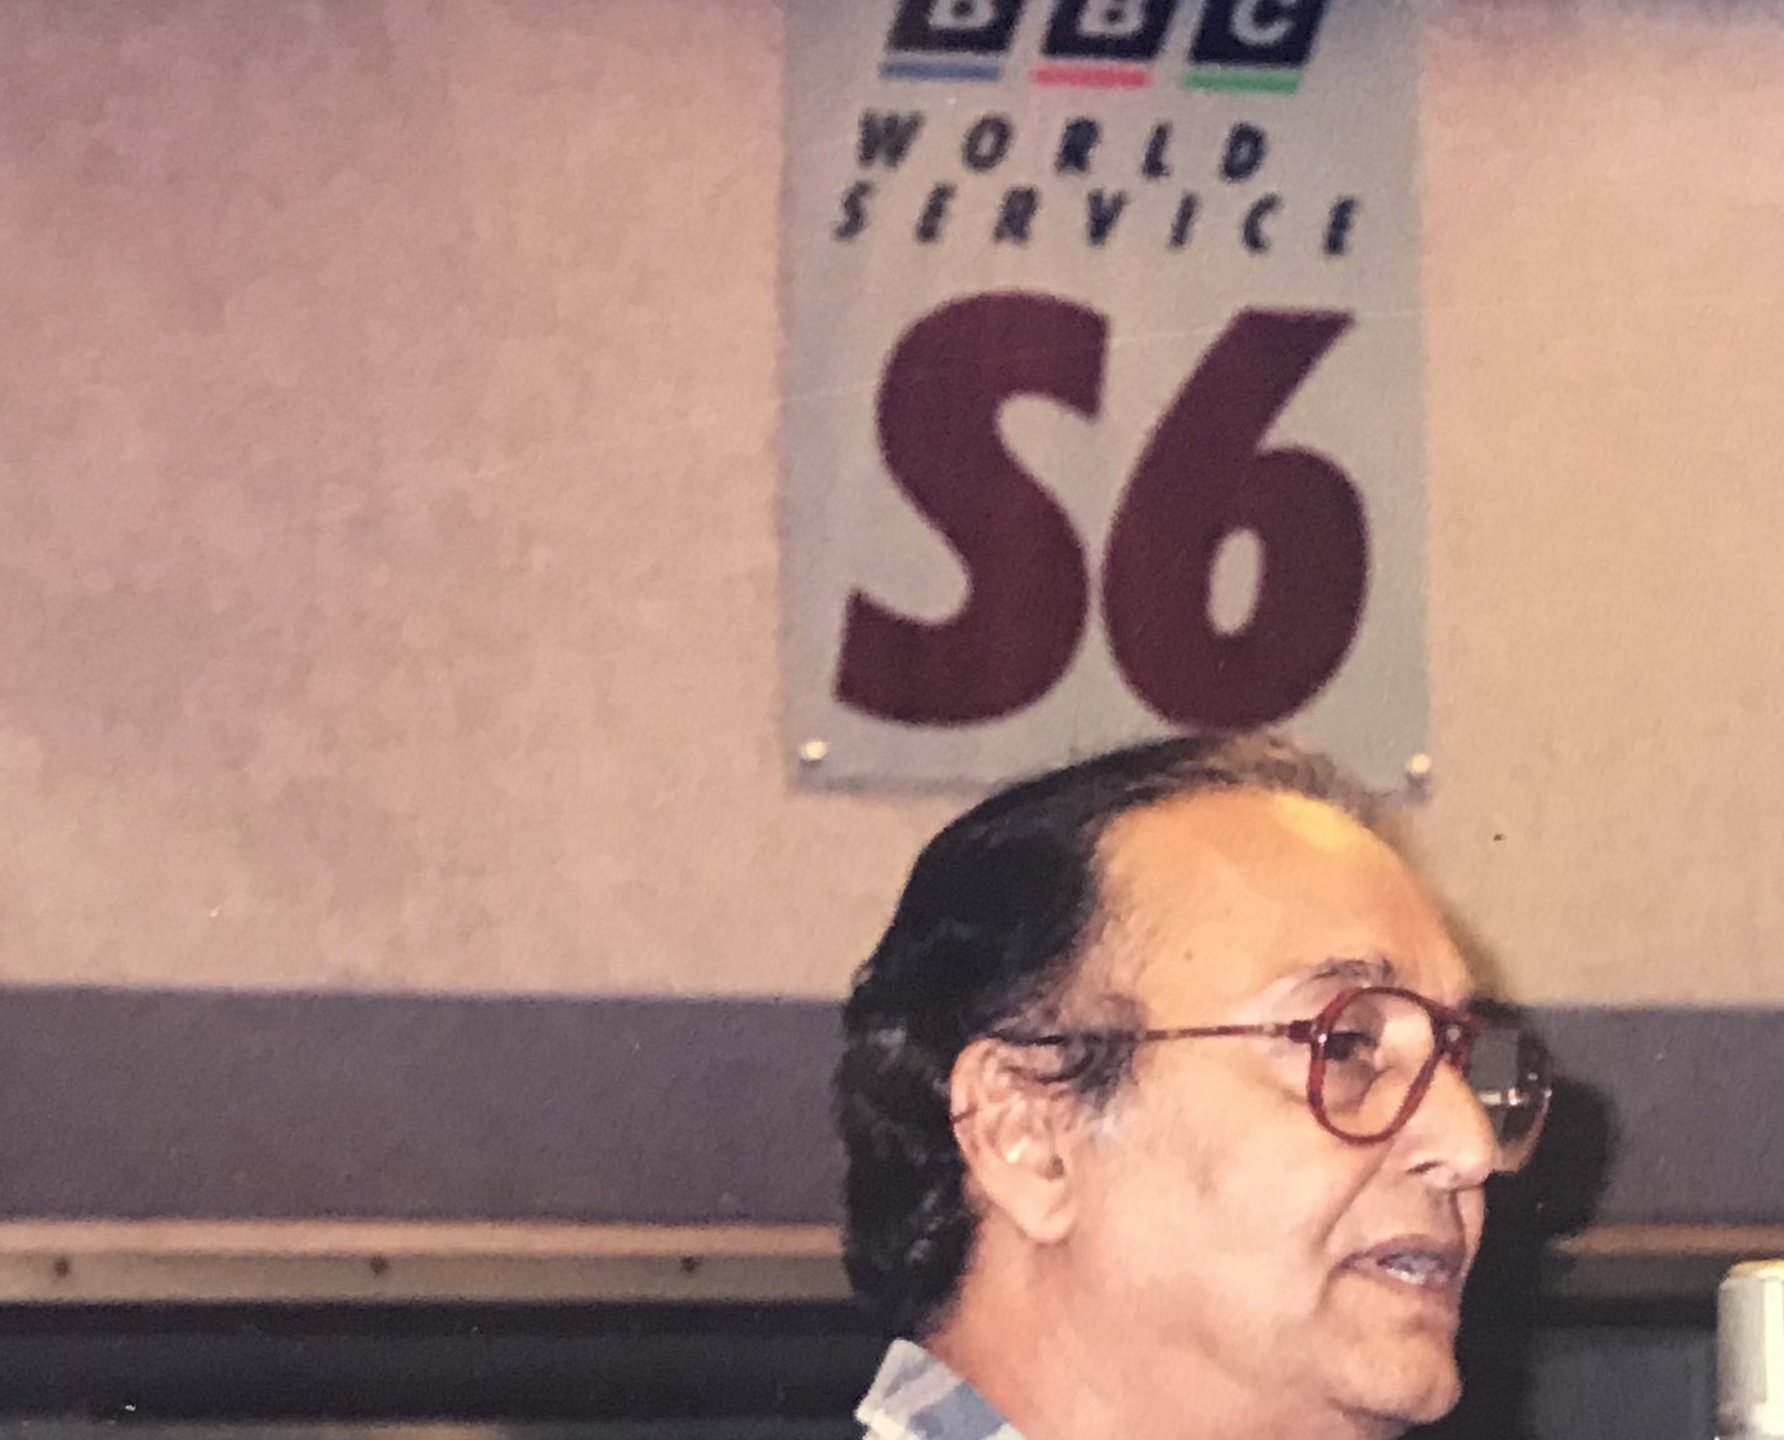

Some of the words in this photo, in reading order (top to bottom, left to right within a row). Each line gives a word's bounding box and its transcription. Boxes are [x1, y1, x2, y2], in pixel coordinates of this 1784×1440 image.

[856, 110, 1270, 182] WORLD
[832, 180, 1360, 257] SERVICE
[833, 291, 1371, 734] S6
